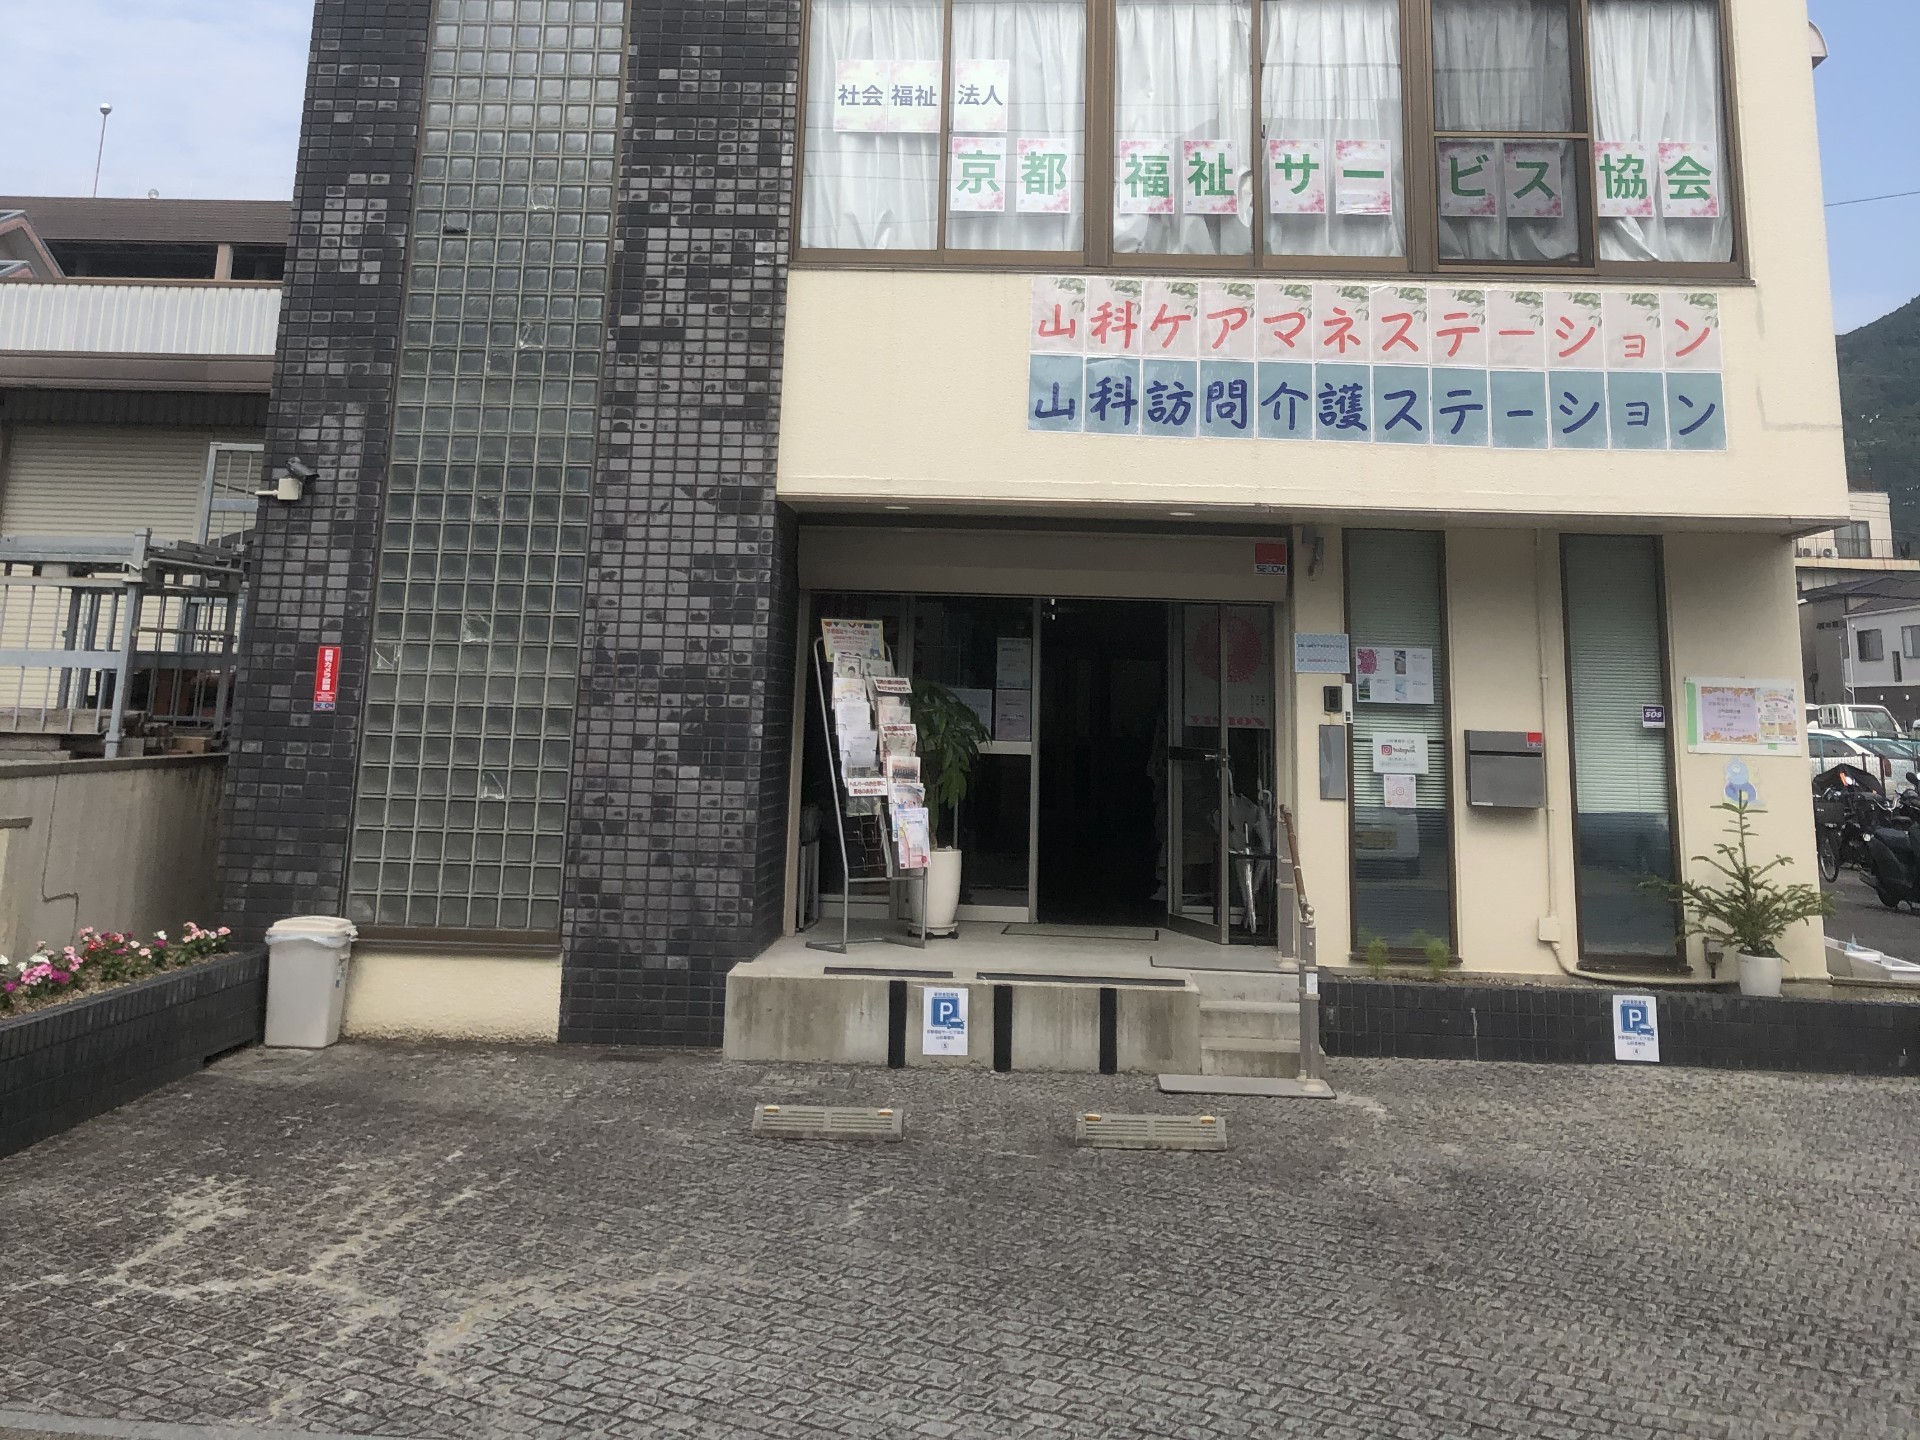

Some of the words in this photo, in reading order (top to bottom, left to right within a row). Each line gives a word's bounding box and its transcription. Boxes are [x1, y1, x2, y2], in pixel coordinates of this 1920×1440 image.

[1037, 299, 1712, 359] 山科ケアマネステーション
[1035, 375, 1716, 435] 山科訪問介護ステーション
[939, 1002, 953, 1022] P
[1628, 1008, 1641, 1029] P
